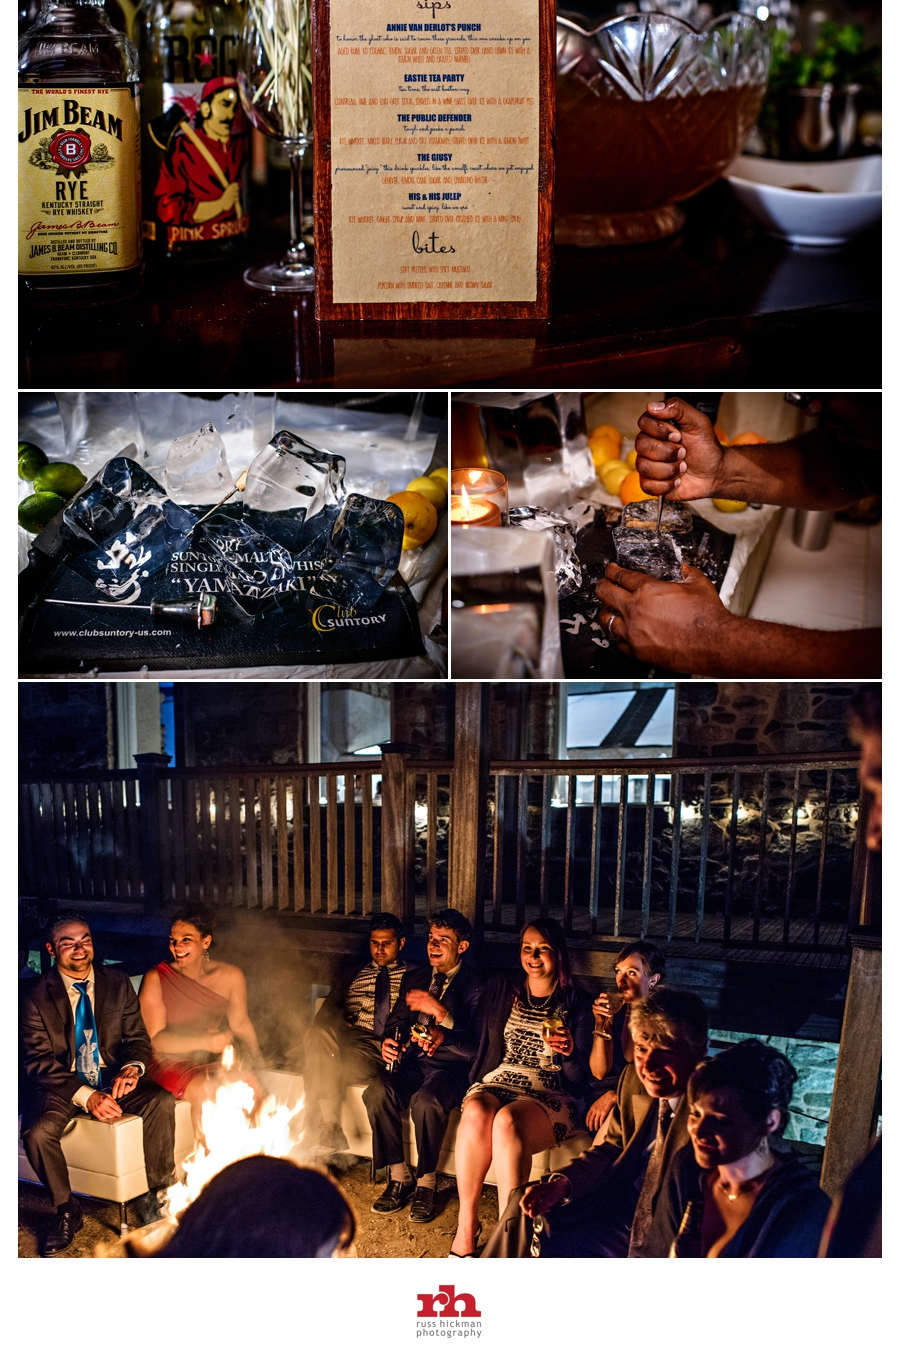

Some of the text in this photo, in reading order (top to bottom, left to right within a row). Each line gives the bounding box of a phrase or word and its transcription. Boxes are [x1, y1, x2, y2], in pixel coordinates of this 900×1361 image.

[404, 74, 465, 82] EASTIE TEA PARTY
[18, 107, 59, 143] JIM
[63, 100, 123, 142] BEAM
[66, 144, 77, 155] B
[56, 181, 88, 200] RYE
[172, 226, 204, 240] PINK
[29, 244, 51, 258] JAMES
[52, 244, 57, 252] B.
[76, 242, 107, 253] DISTILLING
[412, 230, 456, 254] bites
[312, 604, 357, 632] Club
[54, 628, 172, 638] www.clubsuntory-us.com
